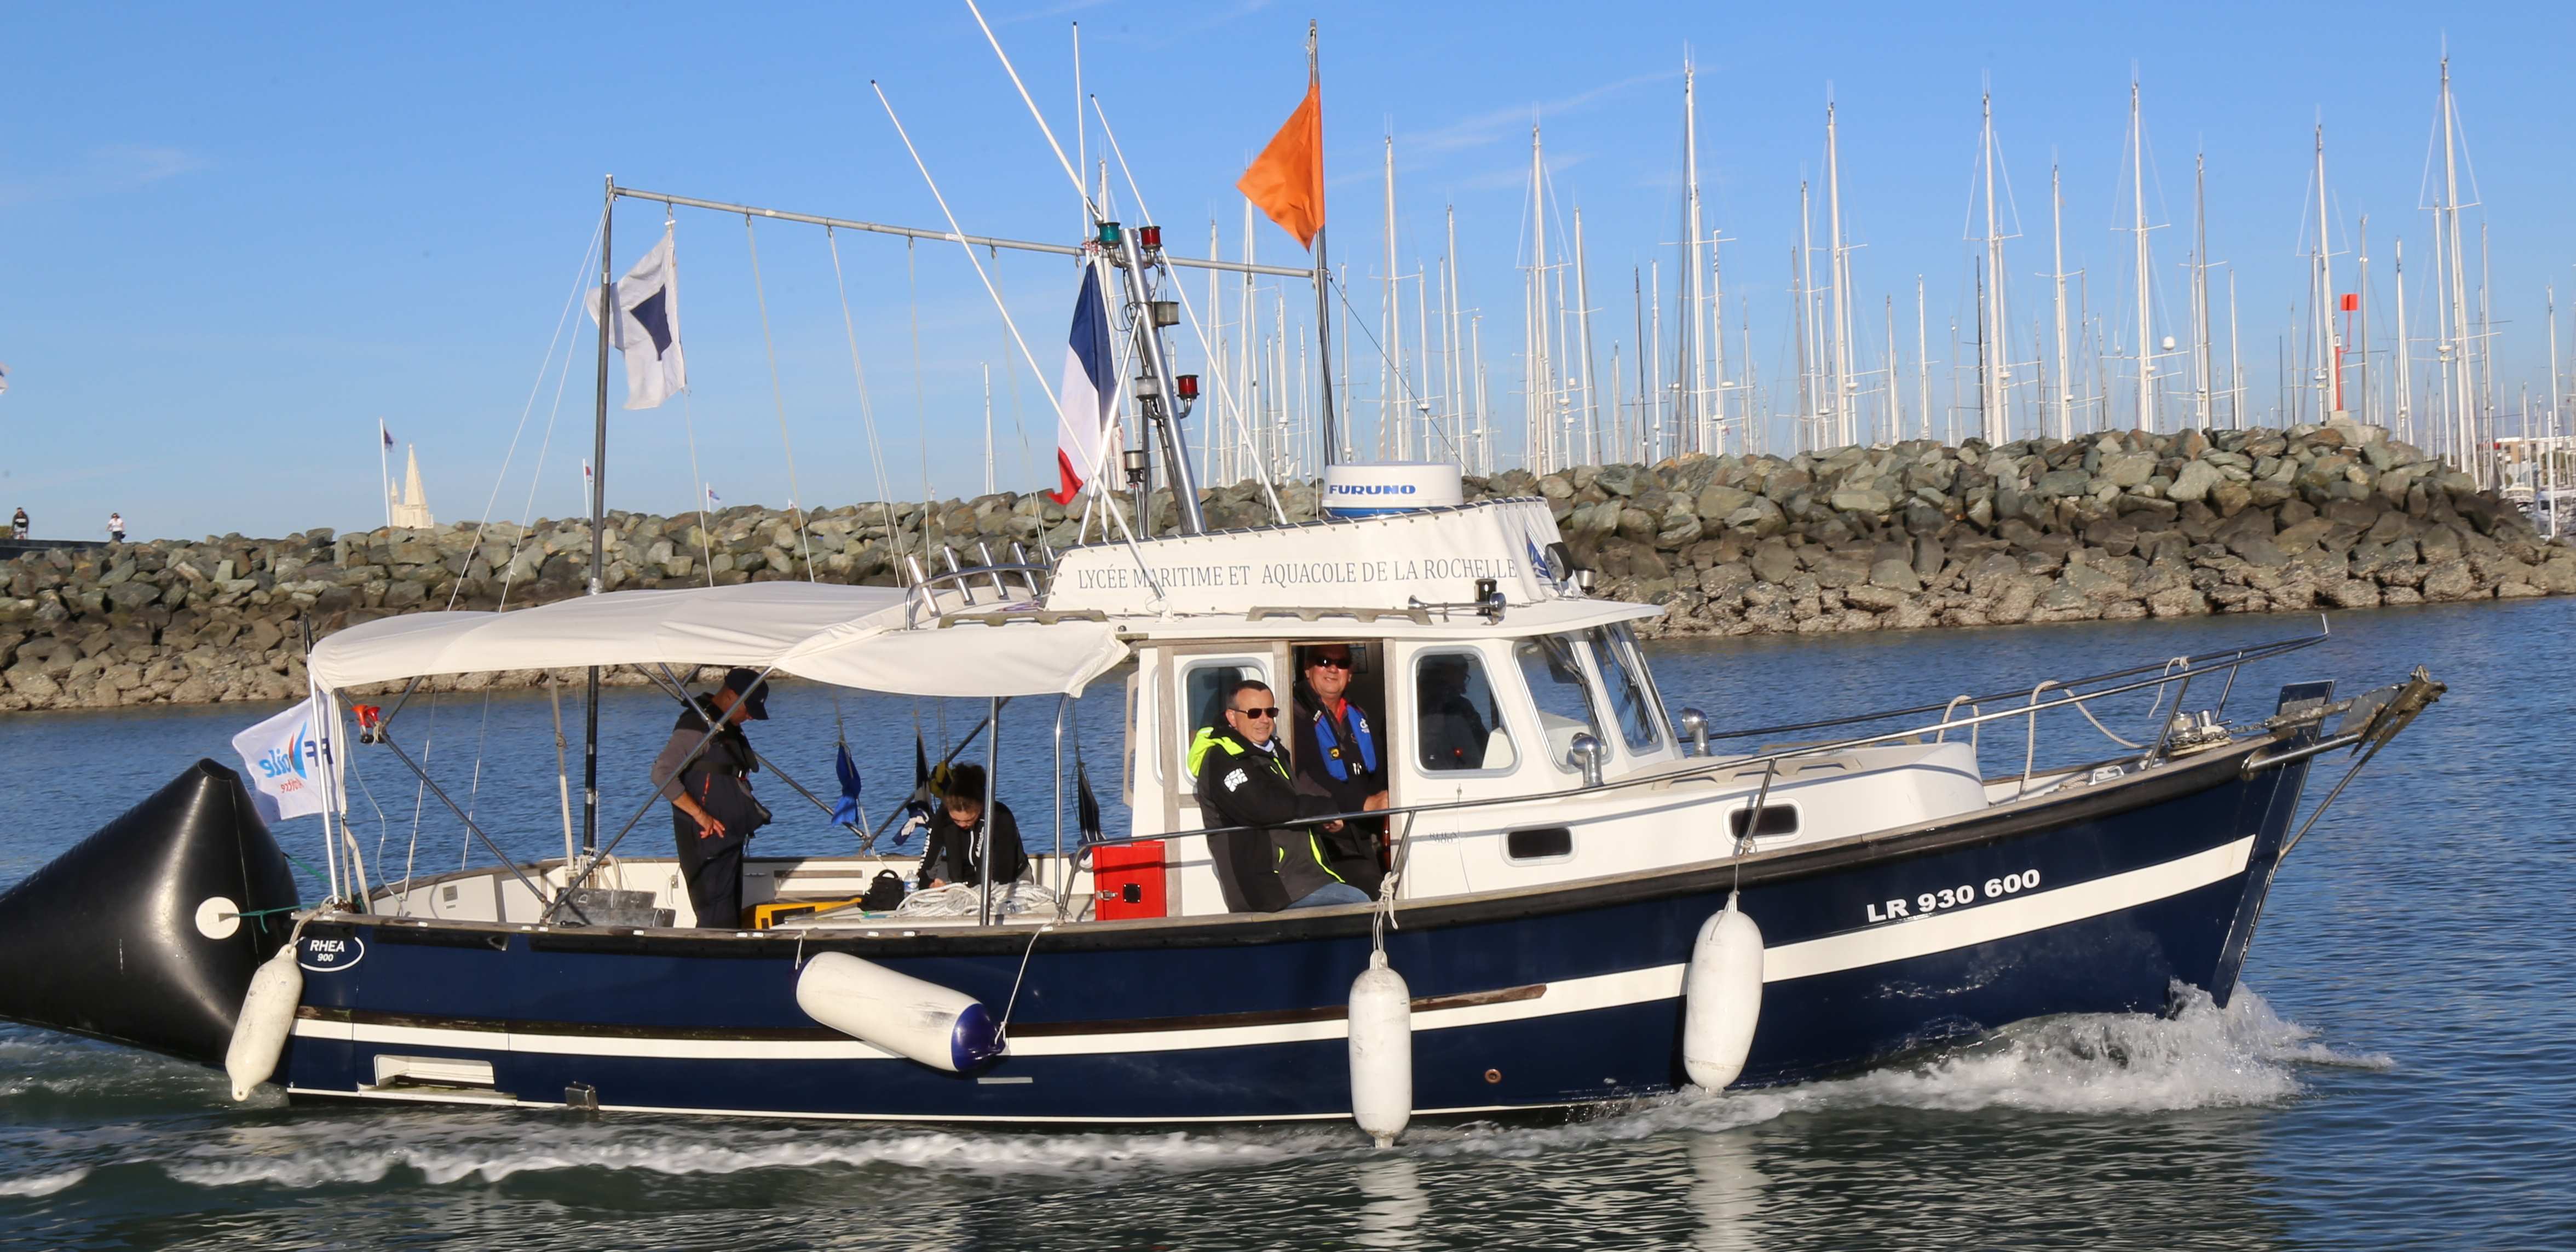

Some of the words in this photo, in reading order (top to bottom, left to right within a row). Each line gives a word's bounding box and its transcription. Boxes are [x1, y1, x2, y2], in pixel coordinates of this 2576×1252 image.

[1329, 485, 1416, 495] FURUNO
[1078, 564, 1128, 589] LYCÉE
[1229, 566, 1250, 585] ET
[1262, 563, 1356, 589] AQUACOLE
[1362, 561, 1387, 582] DE
[1394, 560, 1419, 581] LA
[1424, 558, 1517, 579] ROCHELLE
[1866, 899, 1910, 923] LR
[1917, 885, 1975, 912] 930
[1984, 869, 2041, 898] 600
[309, 940, 345, 952] RHEA
[317, 953, 334, 962] 900
